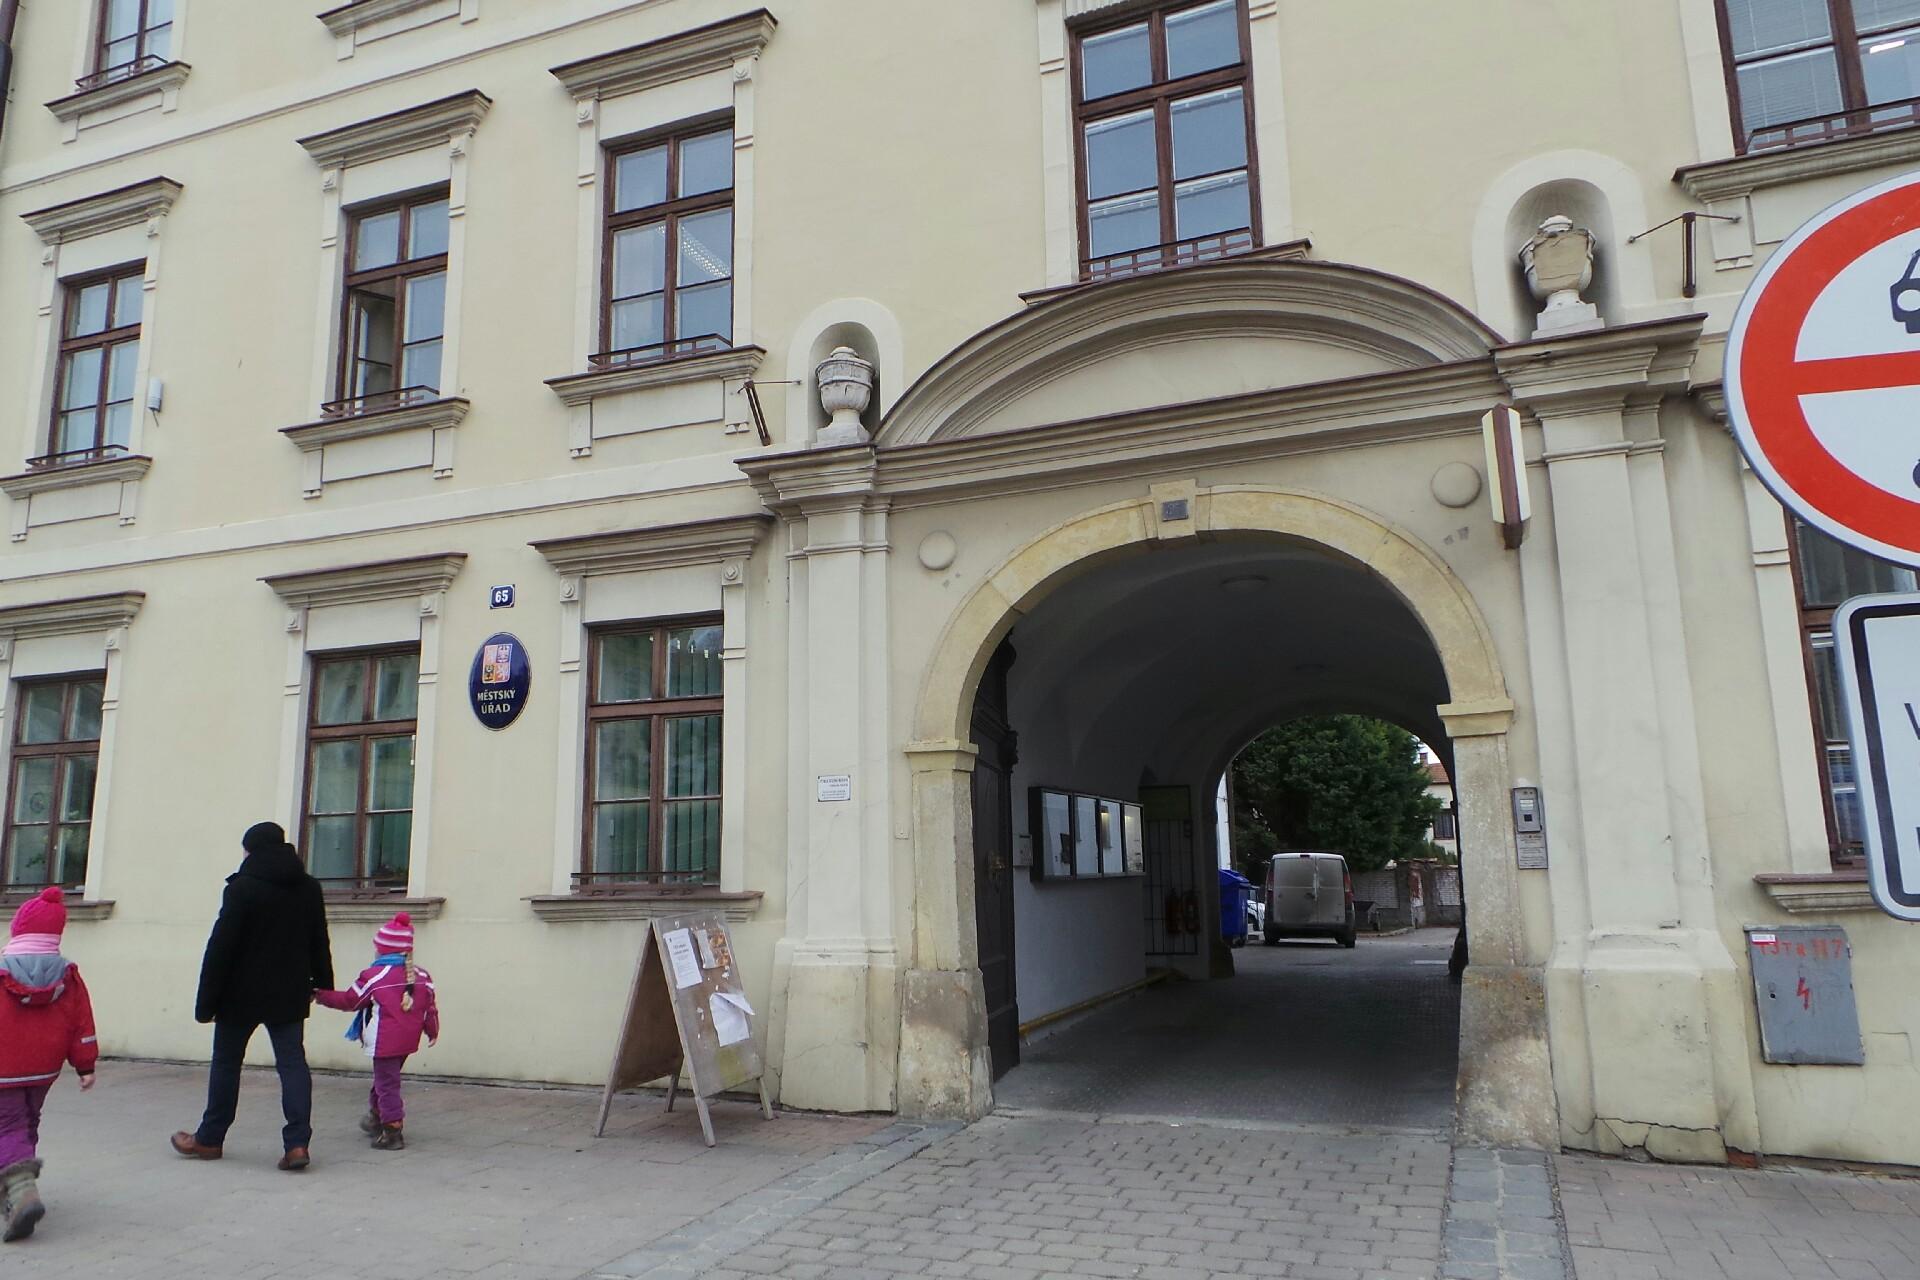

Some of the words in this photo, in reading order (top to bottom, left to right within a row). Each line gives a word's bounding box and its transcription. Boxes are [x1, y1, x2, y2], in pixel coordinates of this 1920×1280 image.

[495, 590, 509, 603] 65
[477, 687, 516, 701] MĚSTSKÝ
[481, 702, 511, 714] ÚŘAD
